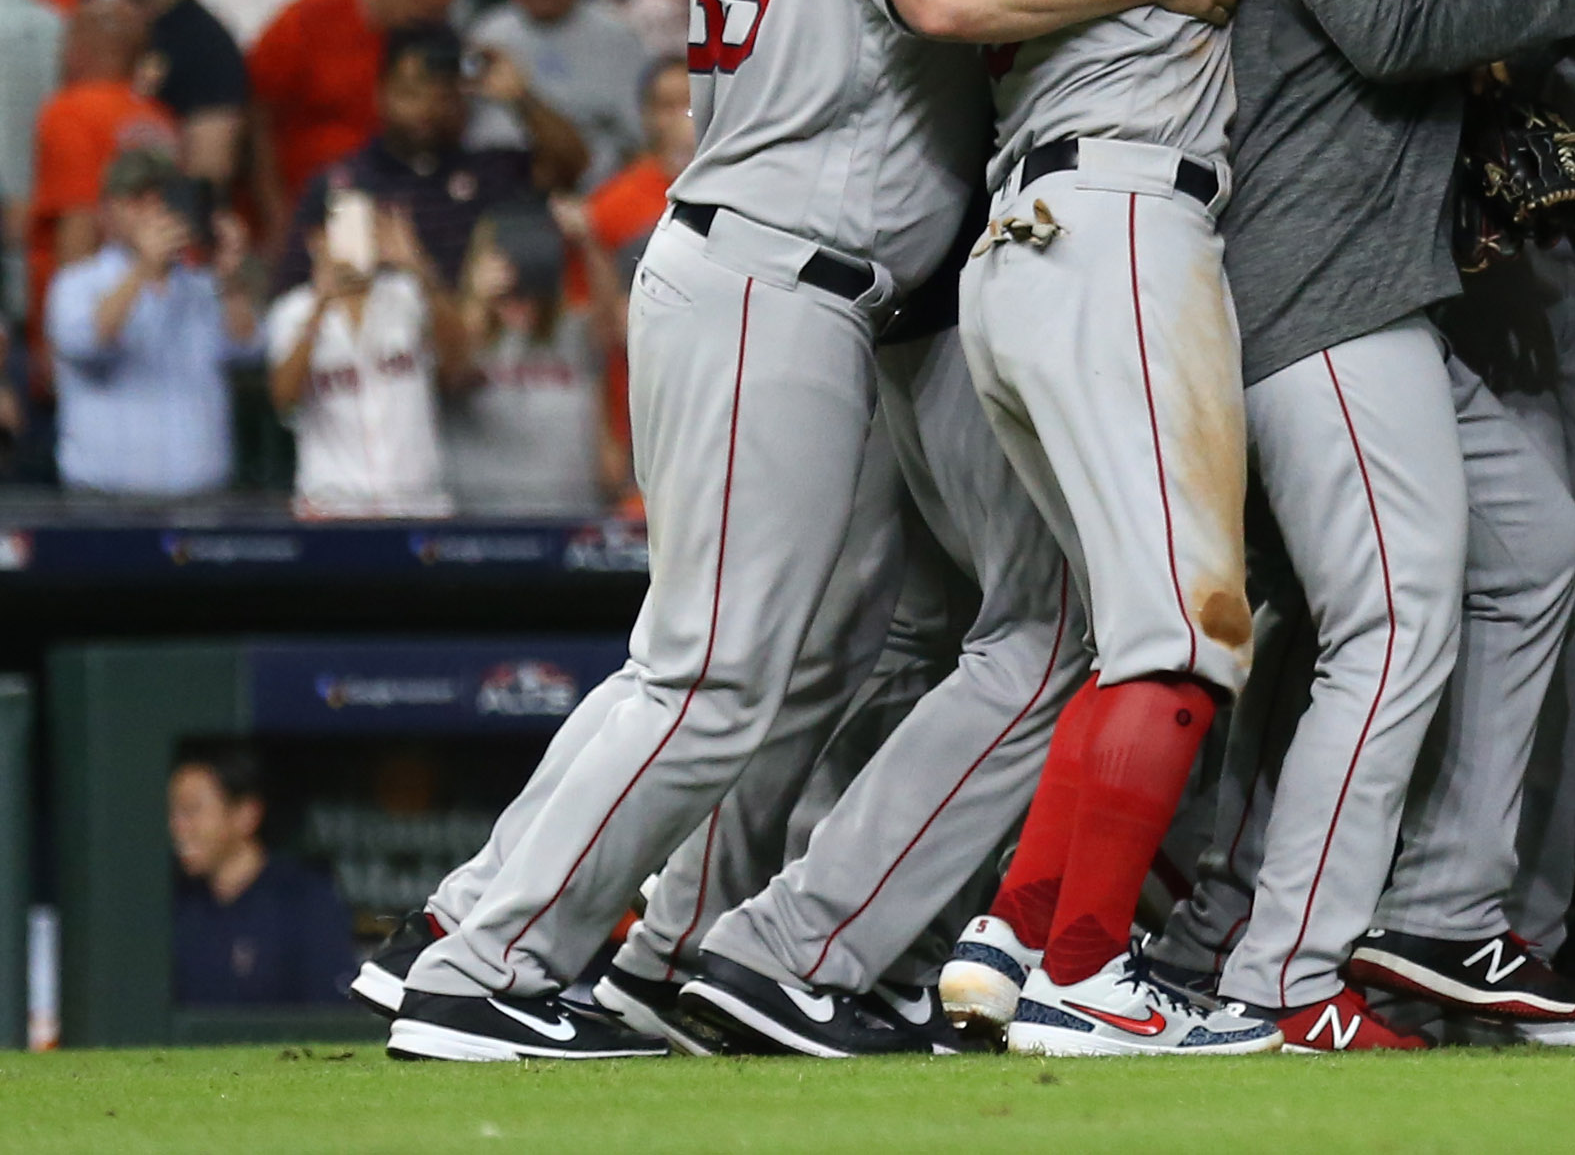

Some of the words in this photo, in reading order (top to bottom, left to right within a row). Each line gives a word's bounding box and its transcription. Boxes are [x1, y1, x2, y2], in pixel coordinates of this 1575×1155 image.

[974, 919, 990, 933] 5
[1463, 937, 1526, 984] N
[1306, 1004, 1362, 1050] N
